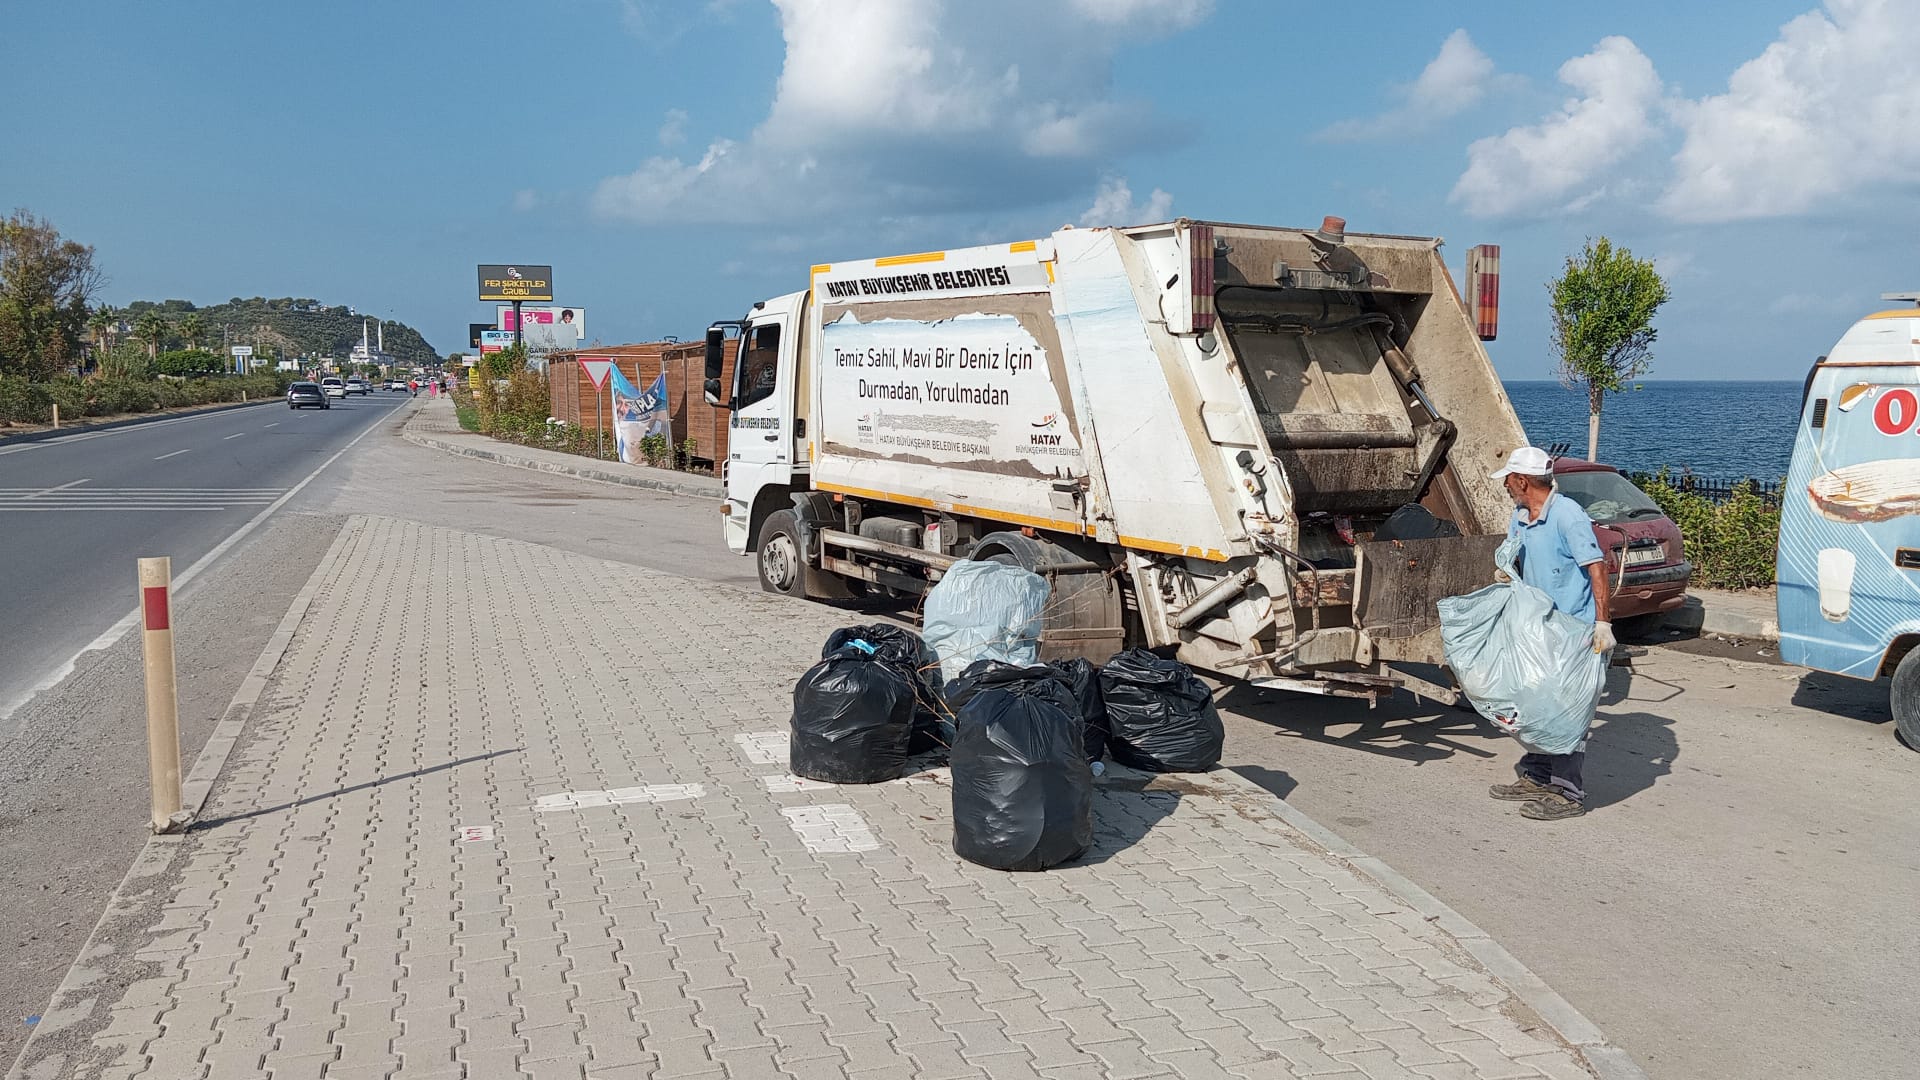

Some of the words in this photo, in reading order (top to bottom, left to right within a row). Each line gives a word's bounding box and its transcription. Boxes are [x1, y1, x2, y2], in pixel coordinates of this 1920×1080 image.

[484, 279, 501, 288] FER
[827, 279, 860, 298] HATAY
[859, 272, 933, 295] BÜYÜKŞEHİR
[933, 265, 1011, 290] BELEDİYESİ
[520, 312, 539, 324] Tek
[834, 347, 864, 368] Temiz
[867, 348, 899, 370] Sahil,
[902, 347, 931, 369] Mavi
[935, 346, 955, 369] Bir
[959, 346, 999, 370] Deniz
[1004, 342, 1033, 376] İçin
[858, 378, 923, 405] Durmadan,
[925, 380, 1010, 406] Yorulmadan
[880, 435, 896, 446] HATAY
[896, 435, 931, 450] BÜYÜKŞEHİR
[931, 439, 961, 453] BELEDİYE
[962, 442, 990, 456] BAŞKANI
[1030, 434, 1061, 446] HATAY
